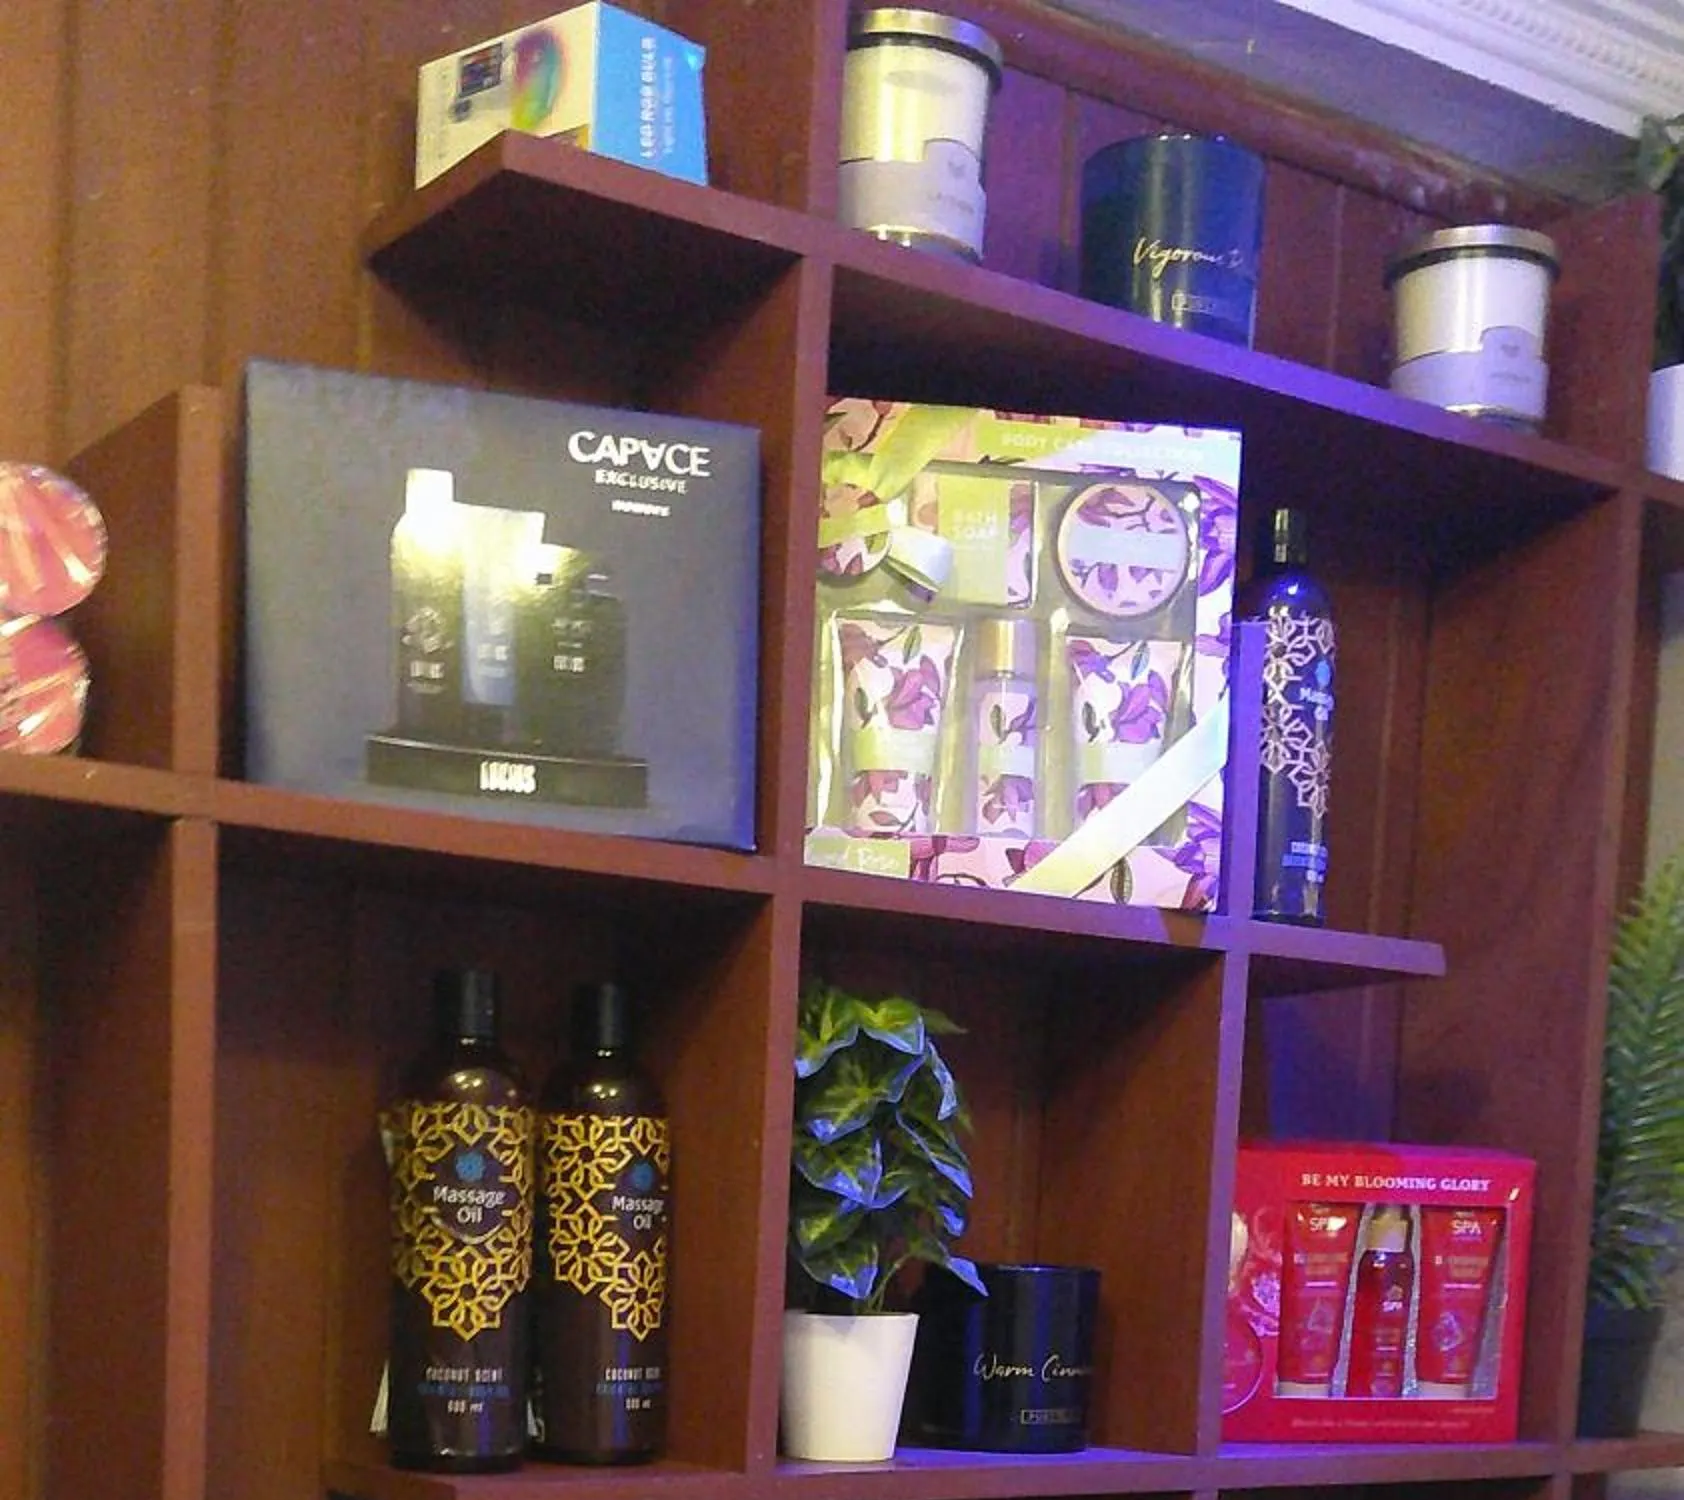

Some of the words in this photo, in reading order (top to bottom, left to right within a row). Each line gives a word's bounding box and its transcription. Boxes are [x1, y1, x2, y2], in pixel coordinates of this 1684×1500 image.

[595, 469, 687, 494] EXCLUSIVE
[1301, 1173, 1321, 1186] BE
[1326, 1174, 1350, 1188] MY
[1354, 1176, 1437, 1190] BLOOMING
[1440, 1178, 1492, 1192] GLORY
[433, 1185, 506, 1209] Massage
[457, 1205, 483, 1224] Oil
[1452, 1219, 1482, 1236] SPA
[973, 1353, 1035, 1381] Warm
